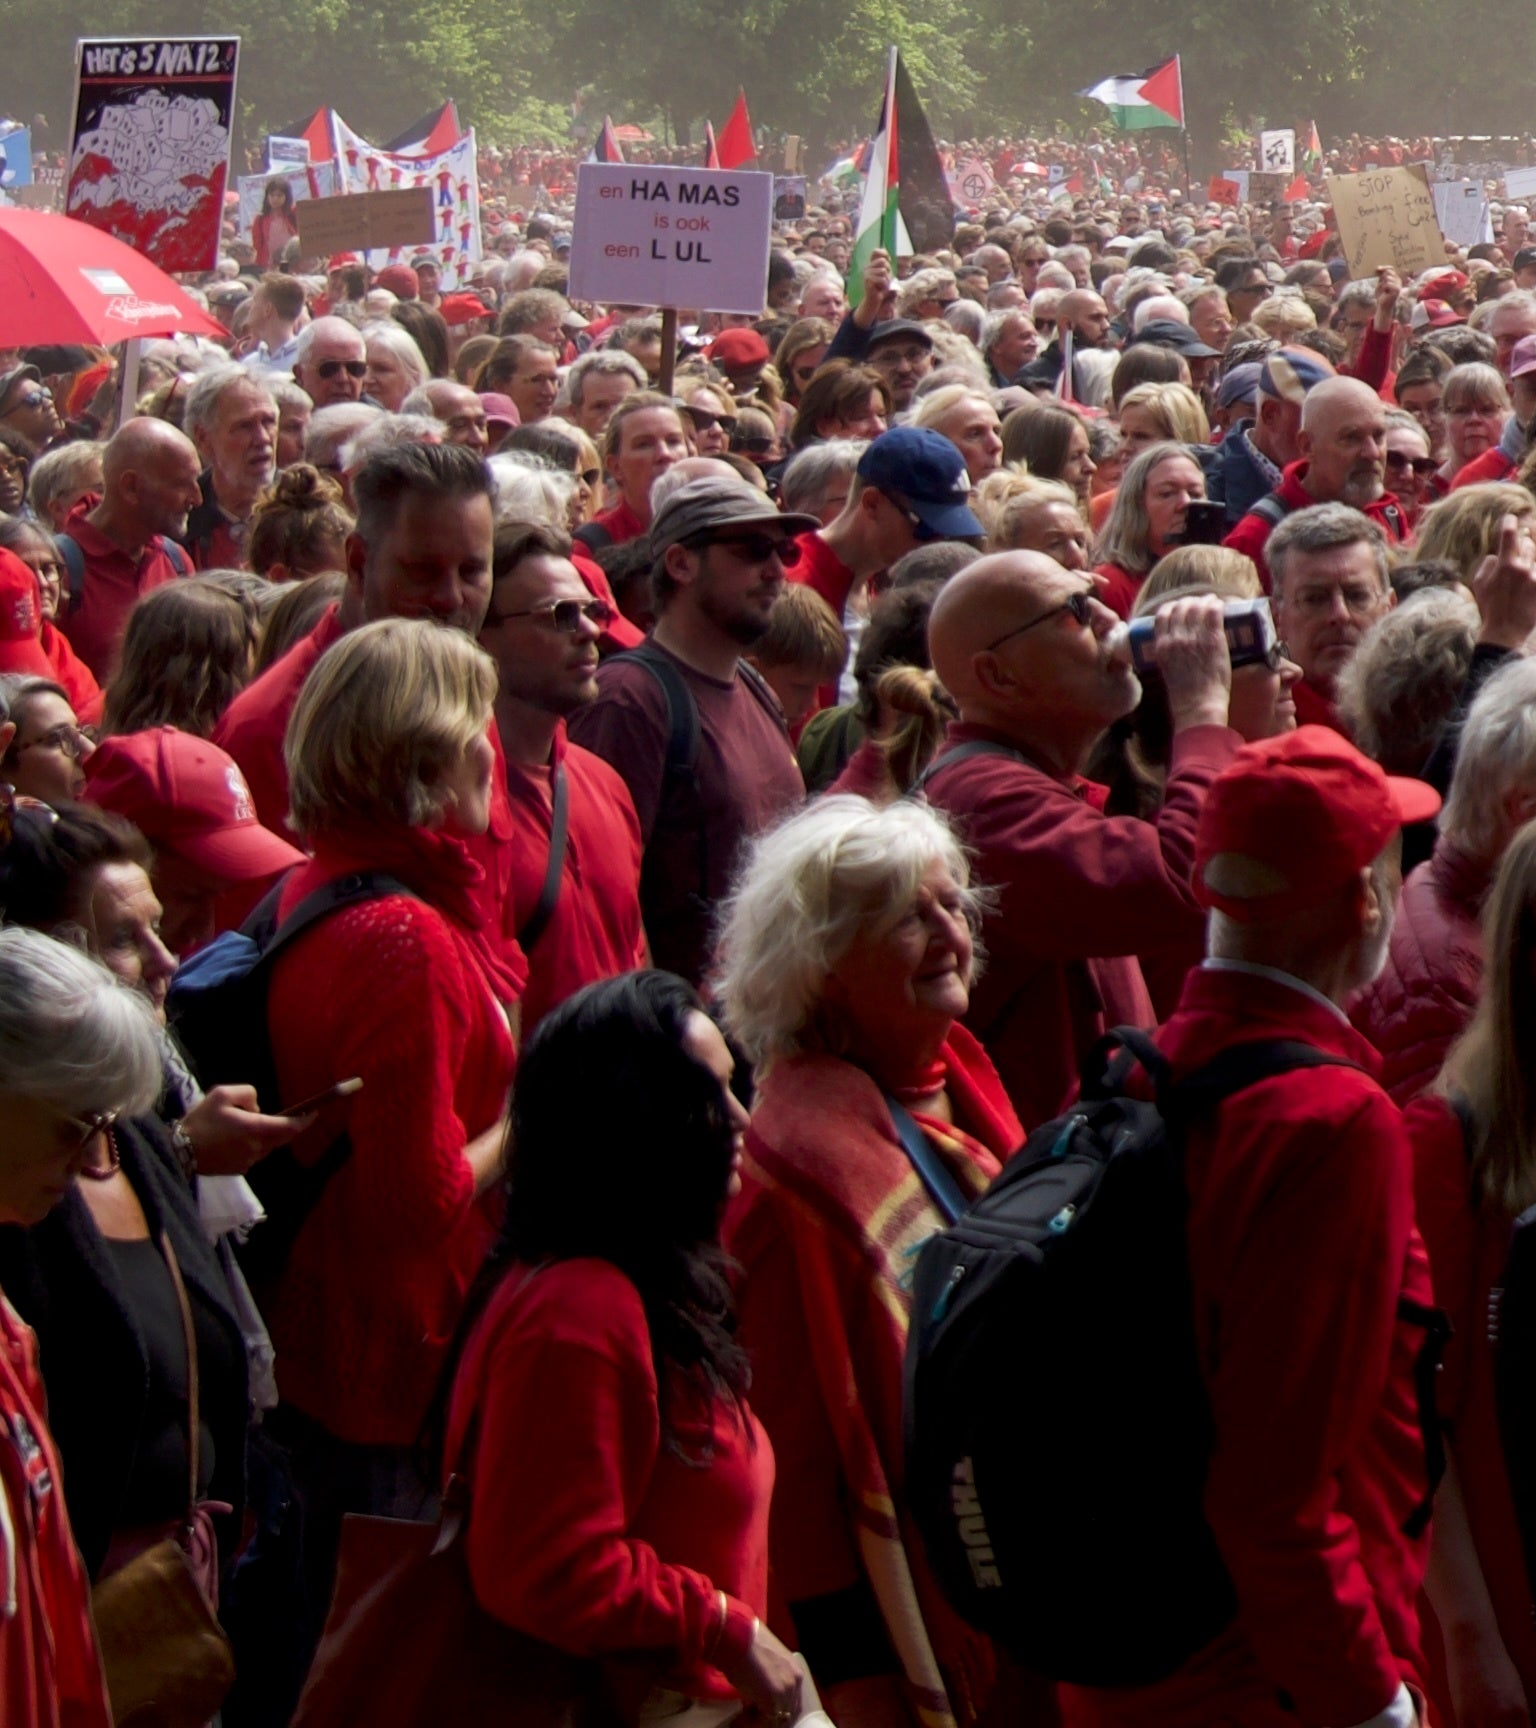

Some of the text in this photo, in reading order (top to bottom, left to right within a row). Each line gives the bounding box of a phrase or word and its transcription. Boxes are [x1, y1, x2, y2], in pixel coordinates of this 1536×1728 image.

[138, 43, 156, 70] 5
[600, 184, 623, 199] en
[1358, 175, 1394, 198] STOP
[653, 212, 711, 233] is ook
[604, 243, 640, 258] een
[951, 1454, 1003, 1589] THULE
